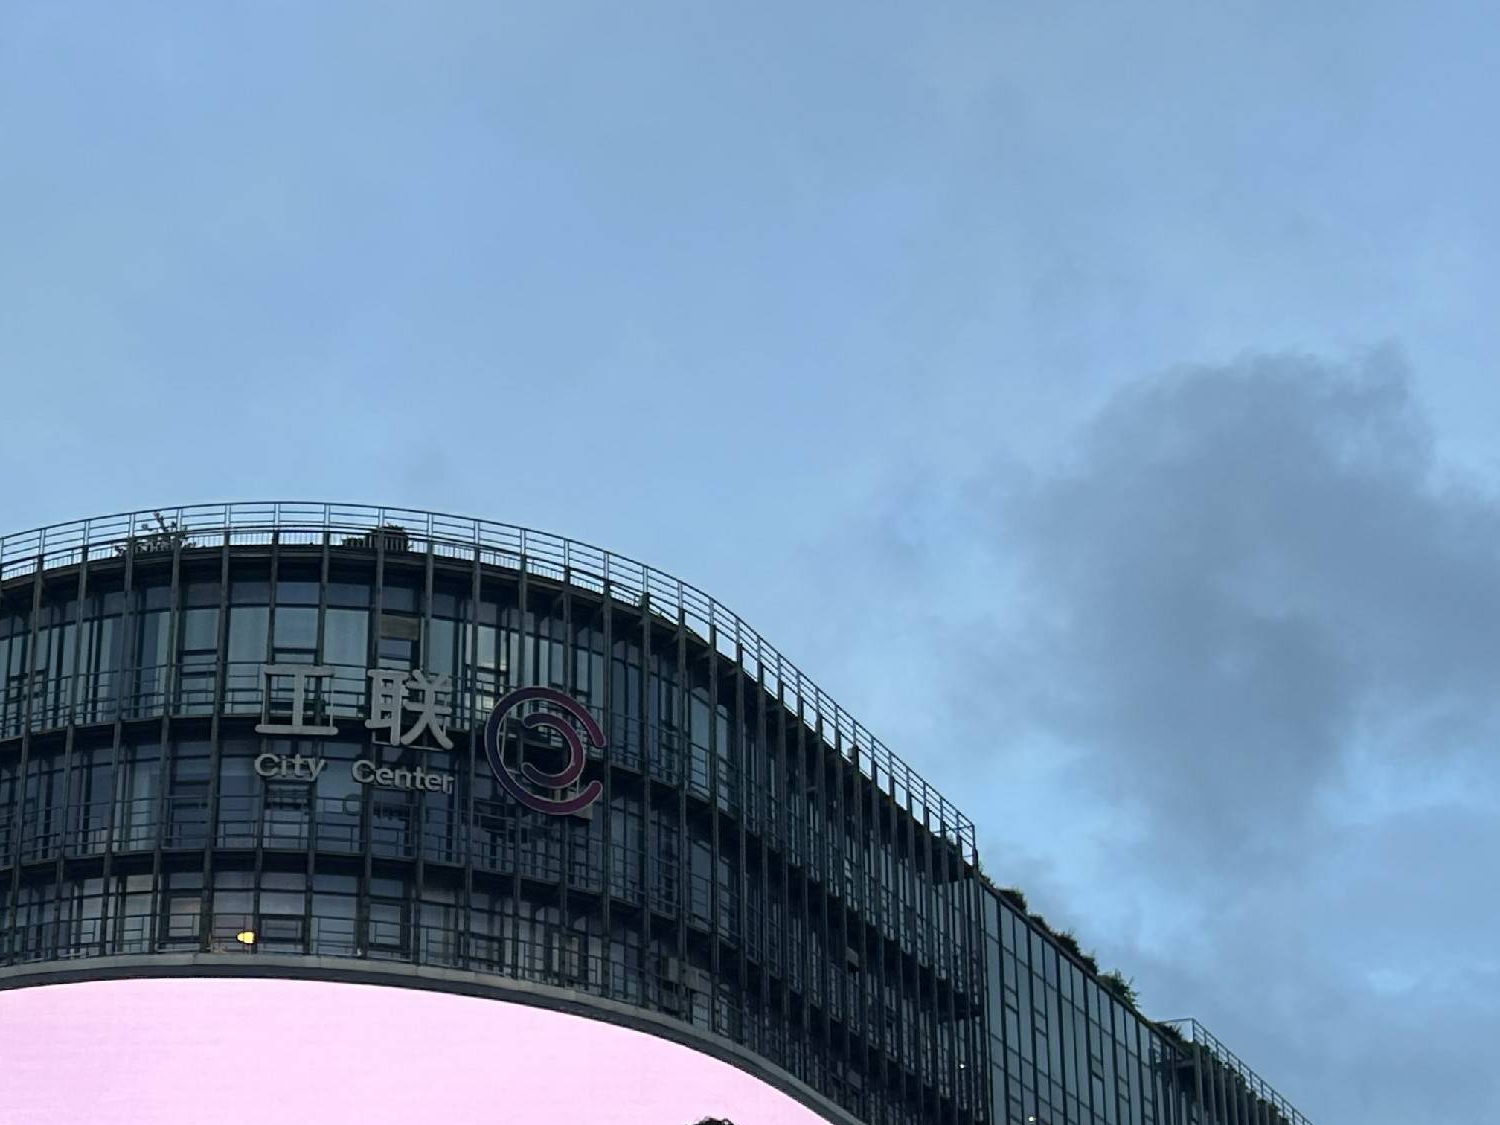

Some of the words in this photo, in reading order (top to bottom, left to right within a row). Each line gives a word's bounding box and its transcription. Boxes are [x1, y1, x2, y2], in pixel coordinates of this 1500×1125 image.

[255, 664, 454, 750] 工联
[254, 753, 327, 782] City
[351, 759, 455, 794] Center
